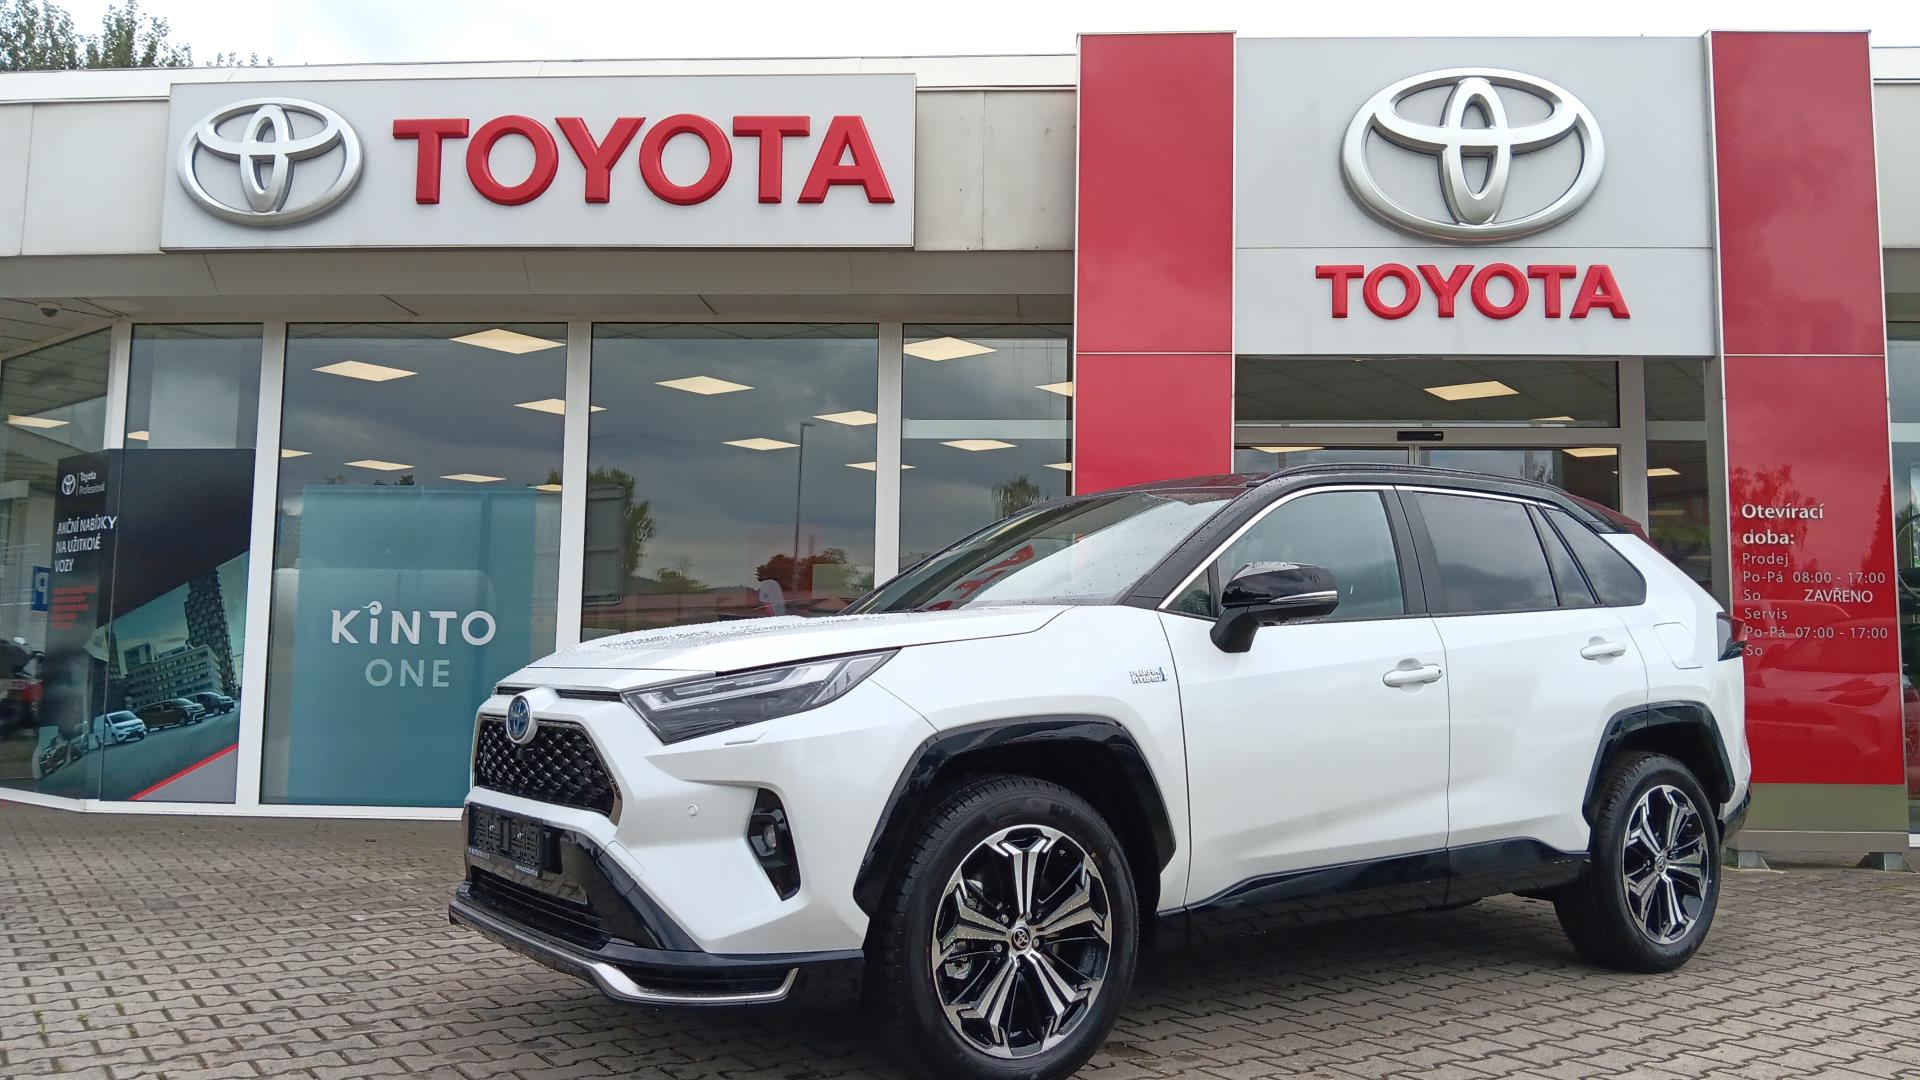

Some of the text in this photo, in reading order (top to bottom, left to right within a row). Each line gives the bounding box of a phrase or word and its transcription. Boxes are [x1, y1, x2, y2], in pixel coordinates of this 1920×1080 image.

[393, 114, 895, 206] TOYOTA
[1315, 263, 1631, 320] TOYOTA
[80, 471, 97, 482] Toyota
[1741, 503, 1824, 519] Otevírací
[57, 514, 117, 535] AKČNÍ NABÍDKY
[55, 533, 101, 554] NA UŽITKOVÉ
[1742, 529, 1795, 545] doba:
[54, 558, 75, 573] VOZY
[1742, 552, 1789, 567] Prodej
[1743, 571, 1784, 584] Po-Pá
[1792, 572, 1832, 584] 08:00
[1848, 572, 1886, 584] 17:00
[1743, 587, 1873, 603] So ZAVŘENO
[1744, 607, 1788, 620] Servis
[1745, 626, 1786, 639] Po-Pá
[1795, 627, 1834, 639] 07:00
[1850, 627, 1888, 639] 17:00
[1746, 644, 1763, 656] So
[365, 658, 450, 687] ONE
